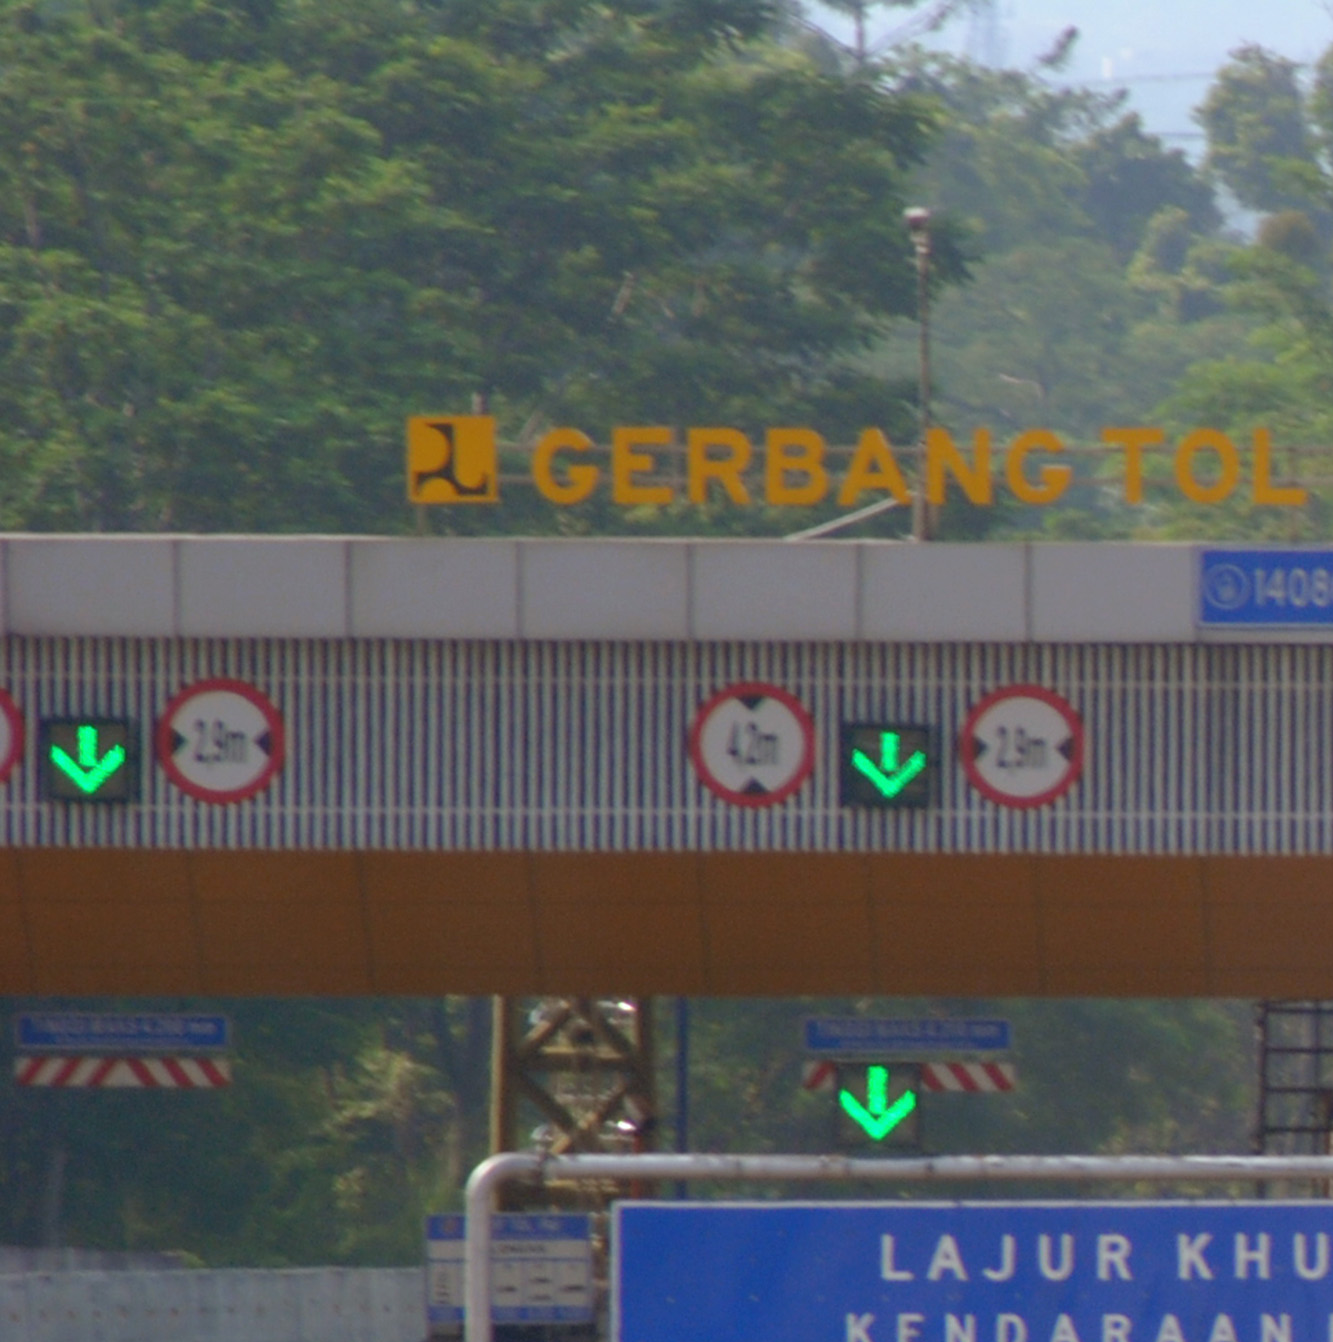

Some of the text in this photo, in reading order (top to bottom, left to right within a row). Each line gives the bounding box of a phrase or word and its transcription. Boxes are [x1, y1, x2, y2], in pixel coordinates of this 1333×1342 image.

[530, 426, 1073, 506] GERBANG
[1100, 426, 1307, 506] TOL
[880, 1233, 1133, 1282] LAJUR
